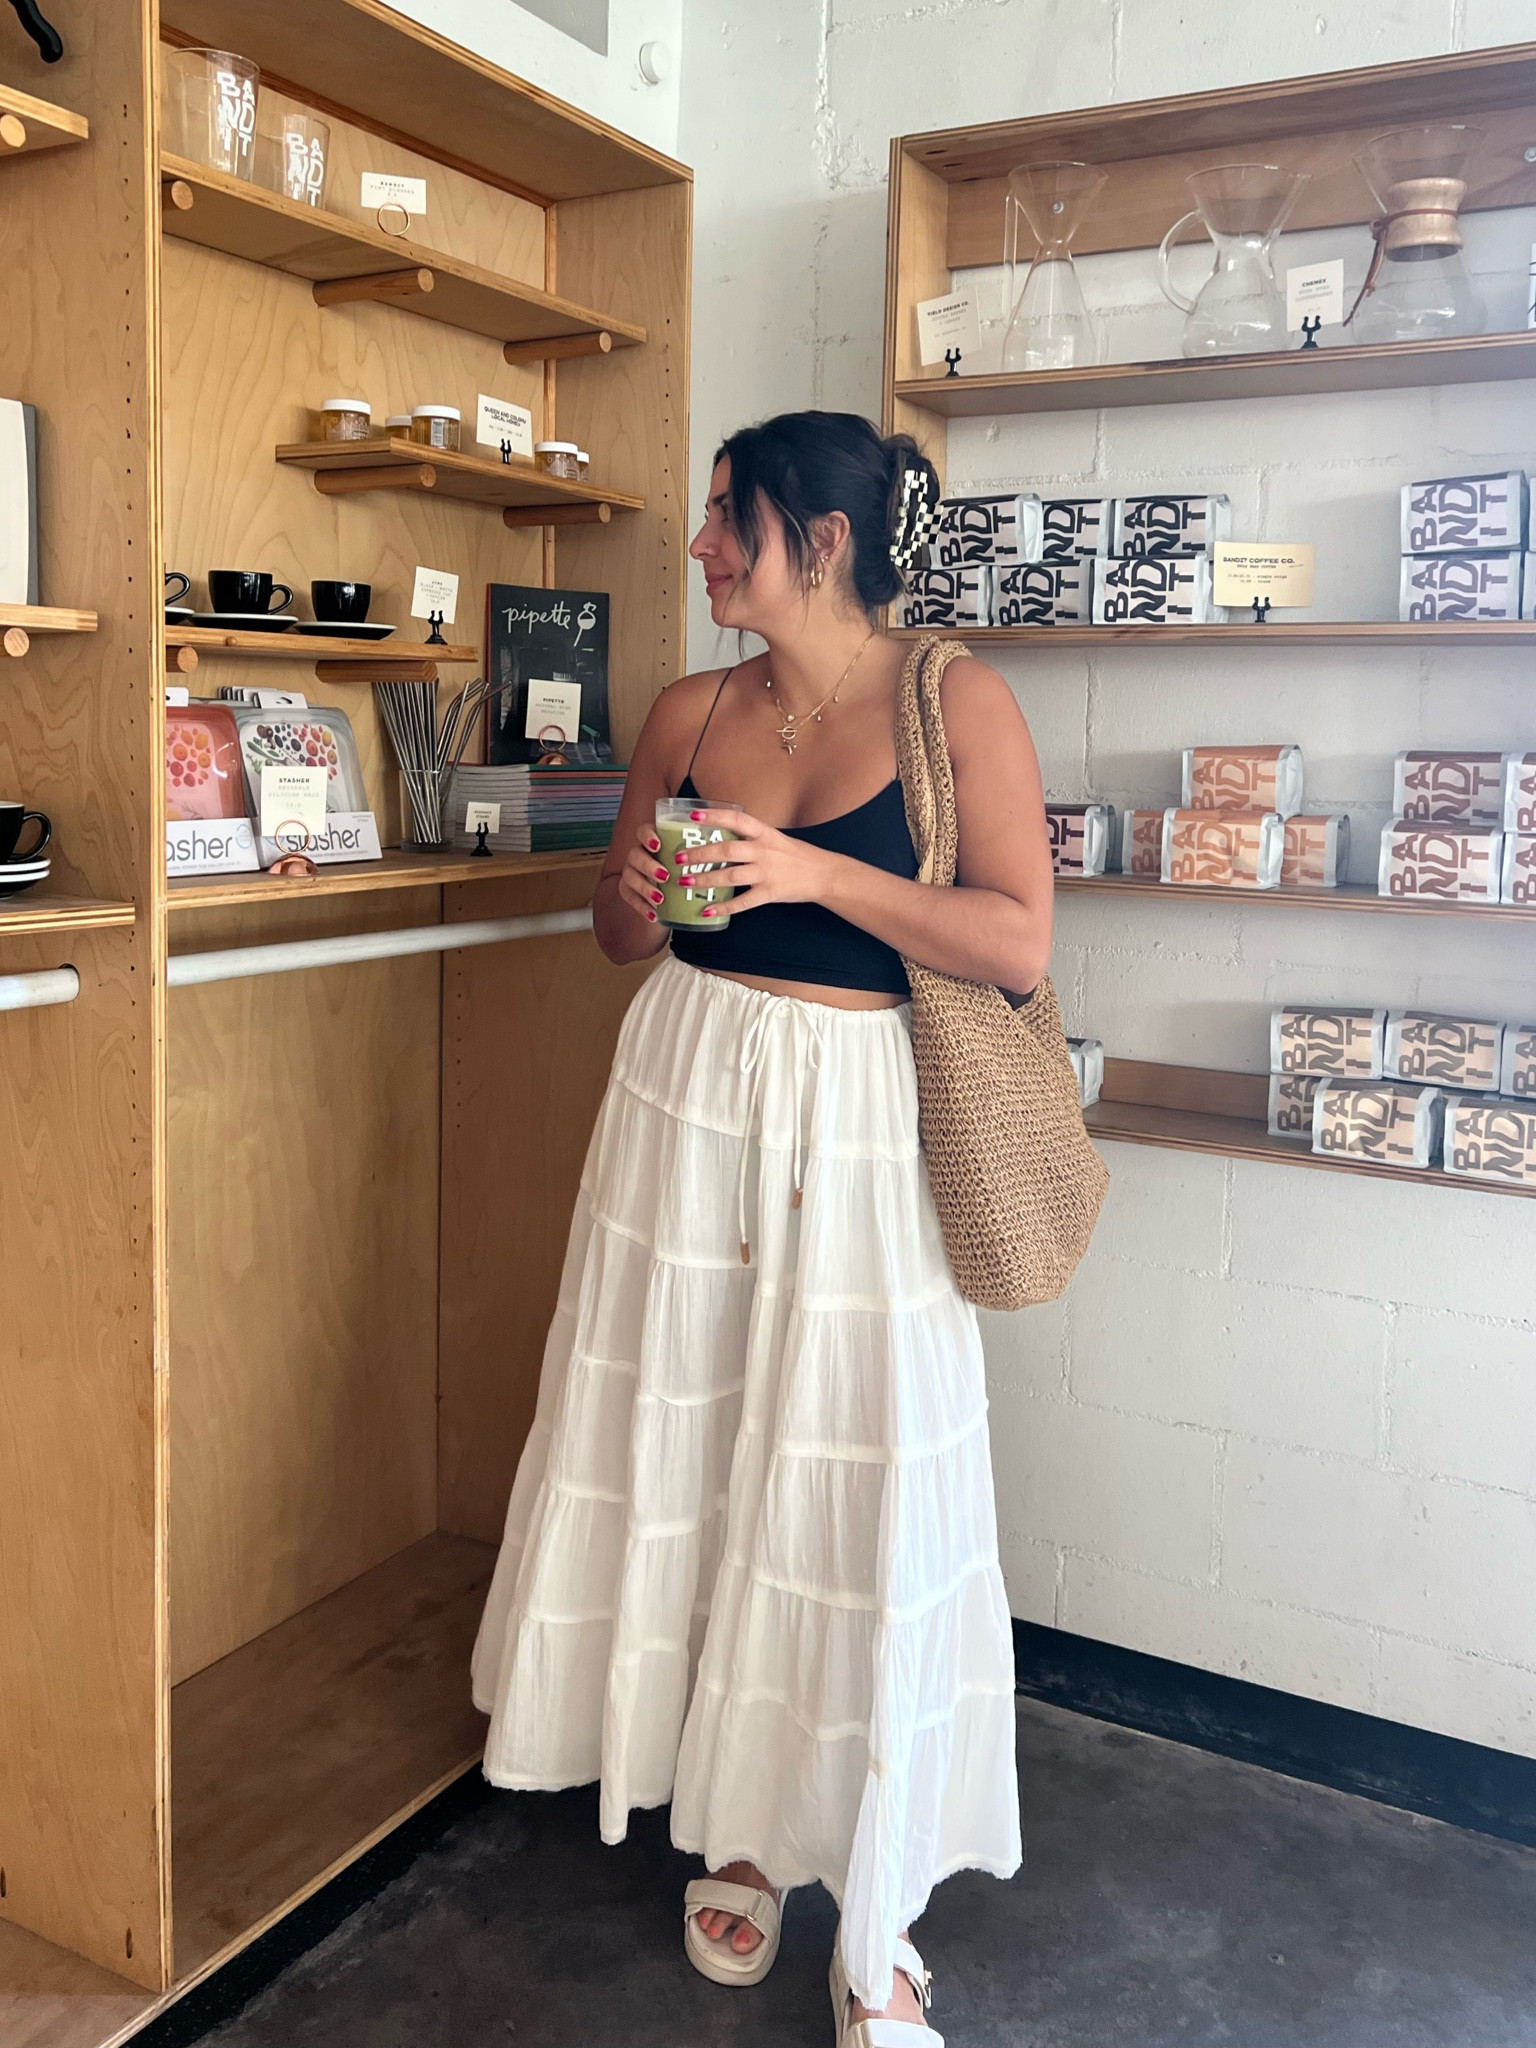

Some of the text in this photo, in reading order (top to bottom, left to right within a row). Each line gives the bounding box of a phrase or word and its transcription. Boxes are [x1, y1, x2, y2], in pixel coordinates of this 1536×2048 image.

[1302, 278, 1326, 287] CHEMEX
[484, 406, 500, 415] QUEEN
[501, 410, 510, 418] AND
[502, 601, 571, 634] pipette
